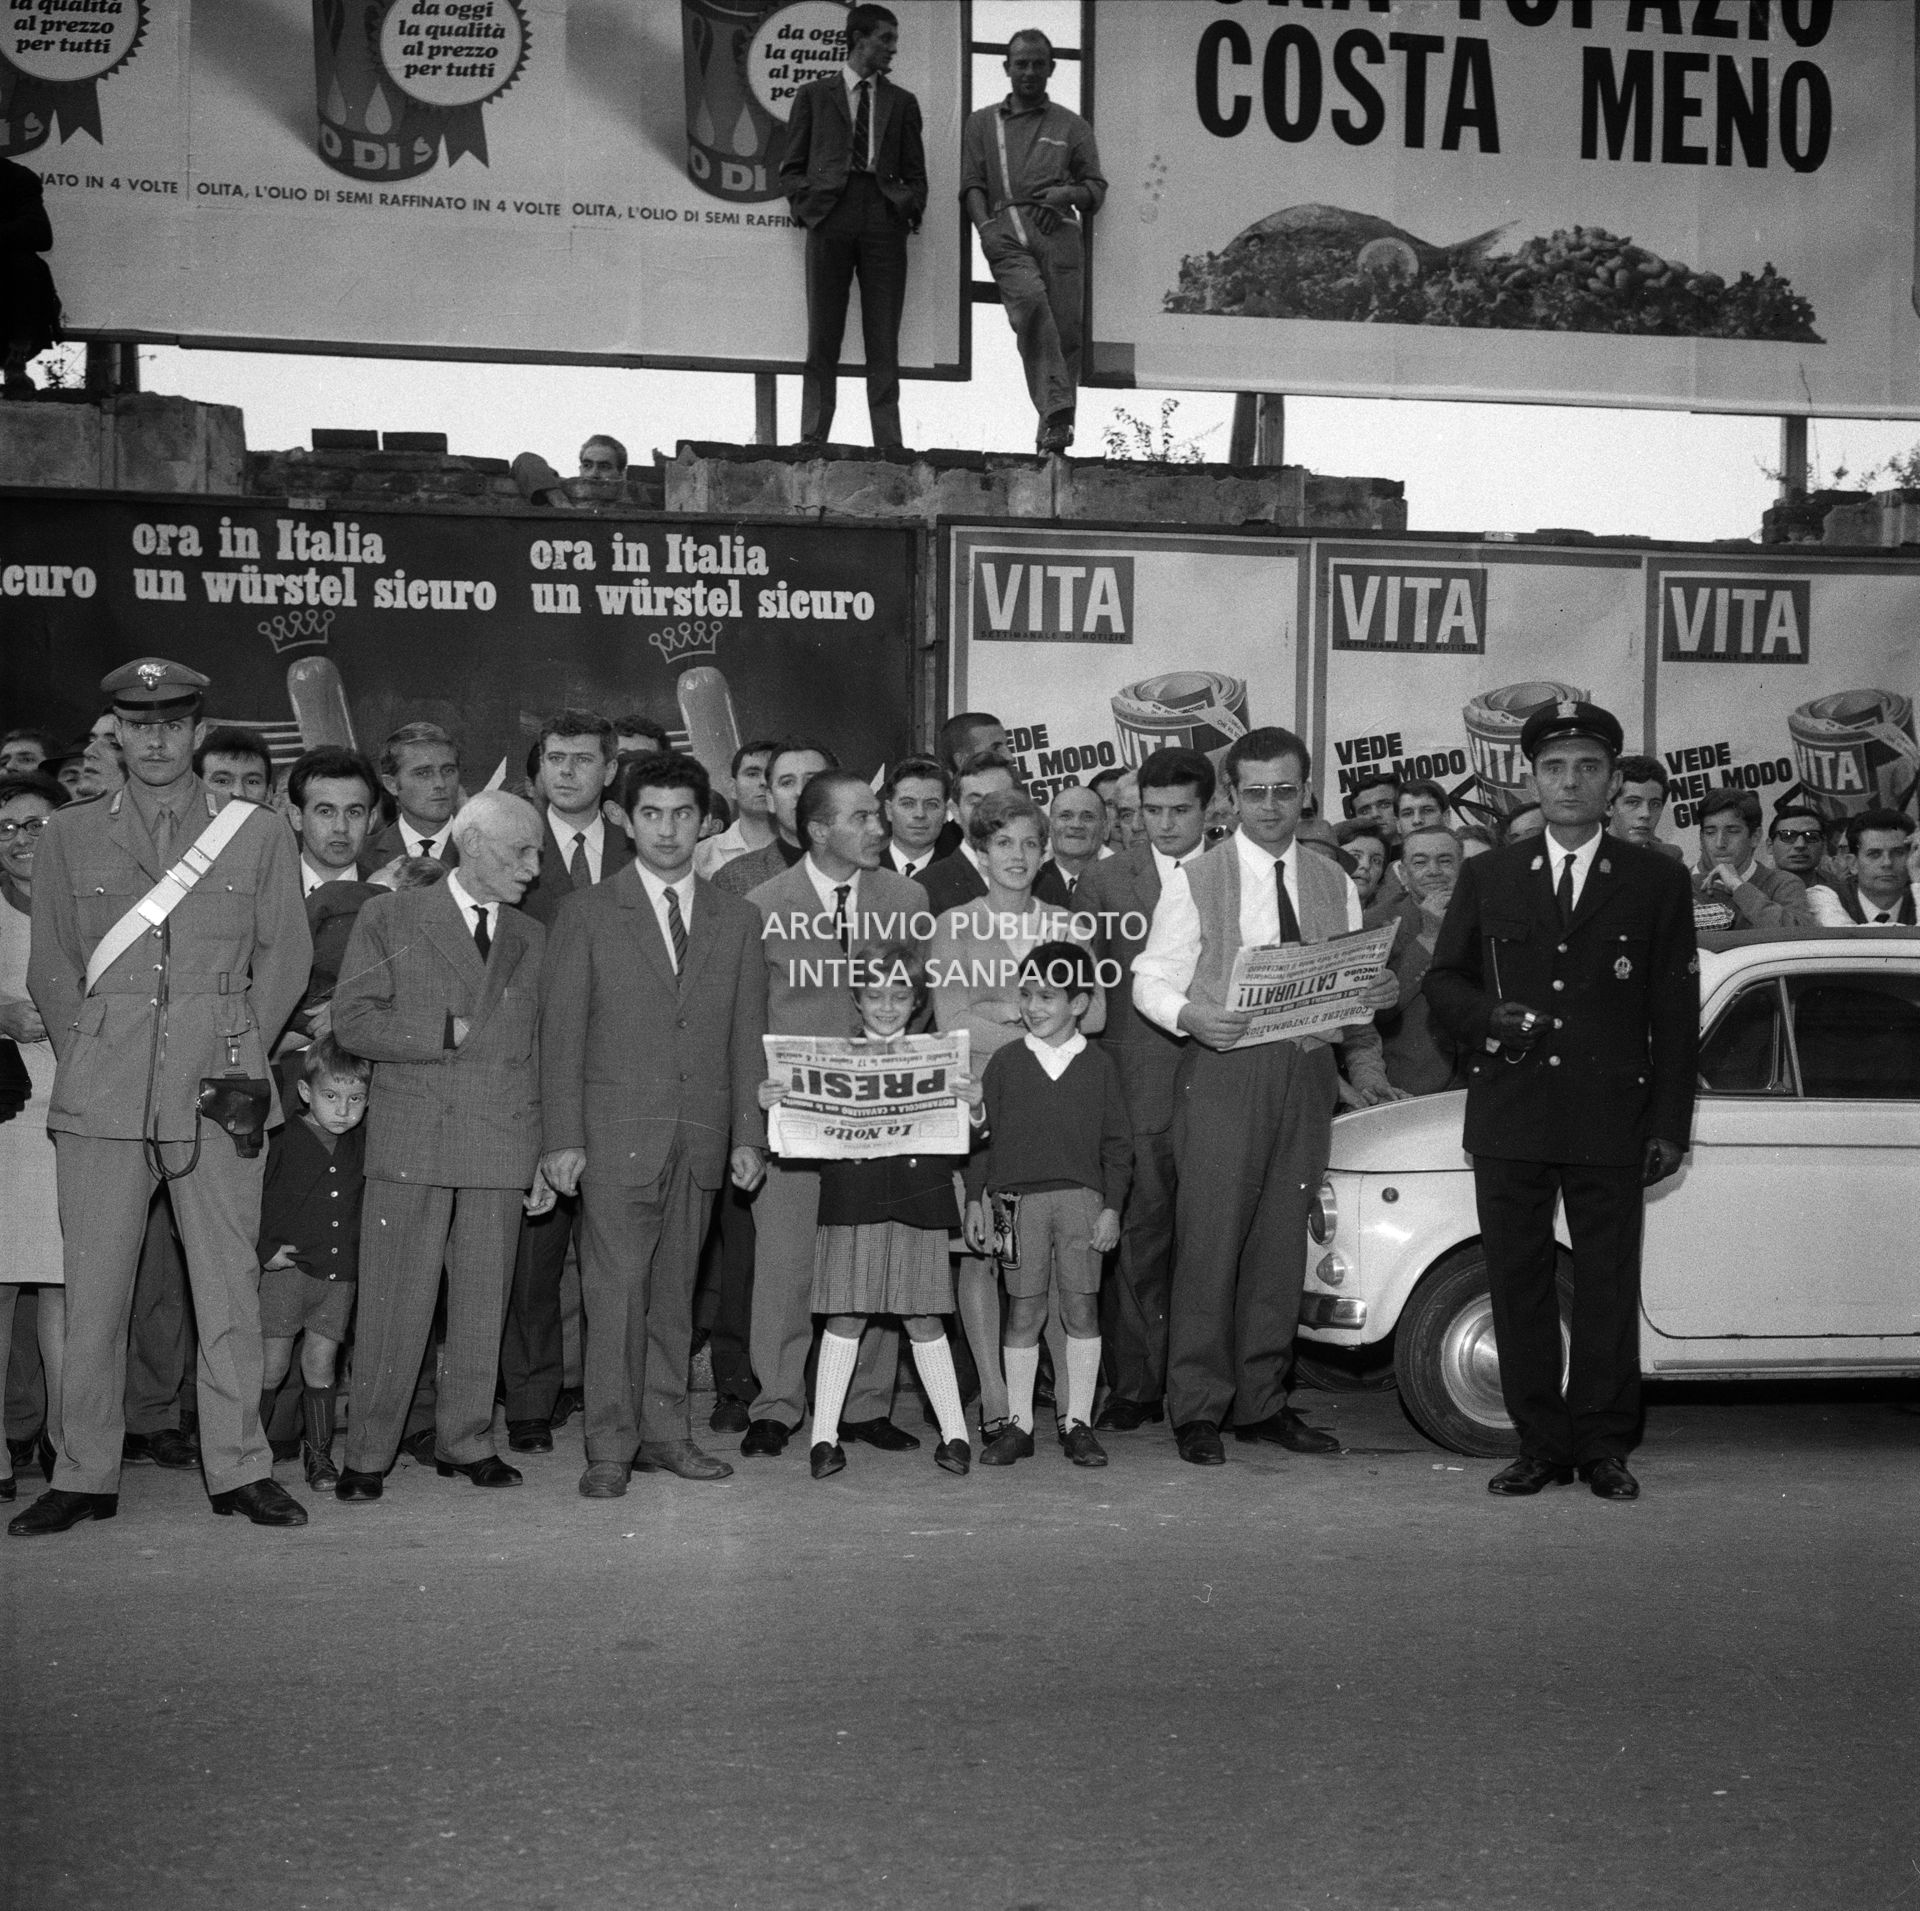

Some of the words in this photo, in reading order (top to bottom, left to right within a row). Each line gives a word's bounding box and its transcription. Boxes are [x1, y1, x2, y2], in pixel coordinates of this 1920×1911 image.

[14, 15, 36, 31] al
[40, 19, 114, 34] prezzo
[412, 0, 440, 16] da
[445, 1, 493, 20] oggi
[399, 20, 420, 36] la
[425, 21, 505, 40] qualità
[778, 24, 804, 40] da
[809, 28, 848, 45] ogg
[16, 39, 55, 53] per
[59, 38, 111, 53] tutti
[403, 41, 424, 56] al
[428, 45, 498, 59] prezzo
[765, 43, 785, 59] la
[791, 47, 848, 64] quali
[404, 64, 442, 78] per
[446, 63, 495, 77] tutti
[769, 64, 789, 79] al
[793, 68, 839, 83] prez
[771, 87, 796, 101] pe
[1196, 19, 1500, 153] COSTA
[1581, 46, 1832, 173] MENO
[86, 176, 103, 188] IN
[110, 178, 121, 190] 4
[128, 178, 178, 194] VOLTE
[197, 182, 249, 198] OLITA,
[255, 185, 307, 201] L'OLIO
[314, 189, 330, 201] DI
[337, 190, 373, 205] SEMI
[379, 193, 466, 210] RAFFINATO
[473, 197, 490, 211] IN
[497, 198, 506, 212] 4
[513, 200, 561, 216] VOLTE
[572, 202, 622, 219] OLITA,
[628, 206, 677, 221] L'OLIO
[684, 210, 699, 223] DI
[705, 211, 740, 225] SEMI
[746, 214, 797, 228] RAFFIN
[133, 522, 202, 556] ora
[219, 517, 260, 559] in
[277, 519, 386, 564] Italia
[530, 538, 596, 571] ora
[611, 532, 650, 572] in
[665, 534, 769, 576] Italia
[0, 564, 97, 598] curo
[133, 567, 186, 601] un
[202, 565, 357, 607] würstel
[374, 569, 497, 611] sicuro
[531, 580, 581, 614] un
[596, 578, 742, 618] würstel
[758, 581, 875, 620] sicuro
[981, 563, 1126, 633] VITA
[1339, 574, 1478, 644] VITA
[1671, 587, 1802, 654] VITA
[1038, 741, 1116, 777] MODO
[1334, 732, 1403, 765] VEDE
[1665, 742, 1731, 775] VEDE
[1392, 749, 1466, 783] MODO
[1721, 757, 1793, 790] MODO
[1238, 971, 1338, 1008] CATTURATI!
[1244, 1016, 1319, 1037] D'INFORMAZION
[1321, 1004, 1369, 1022] CORRIERE
[857, 1059, 867, 1068] 17
[790, 1067, 946, 1102] PRESI!
[823, 1125, 883, 1140] Notte
[887, 1124, 914, 1138] La
